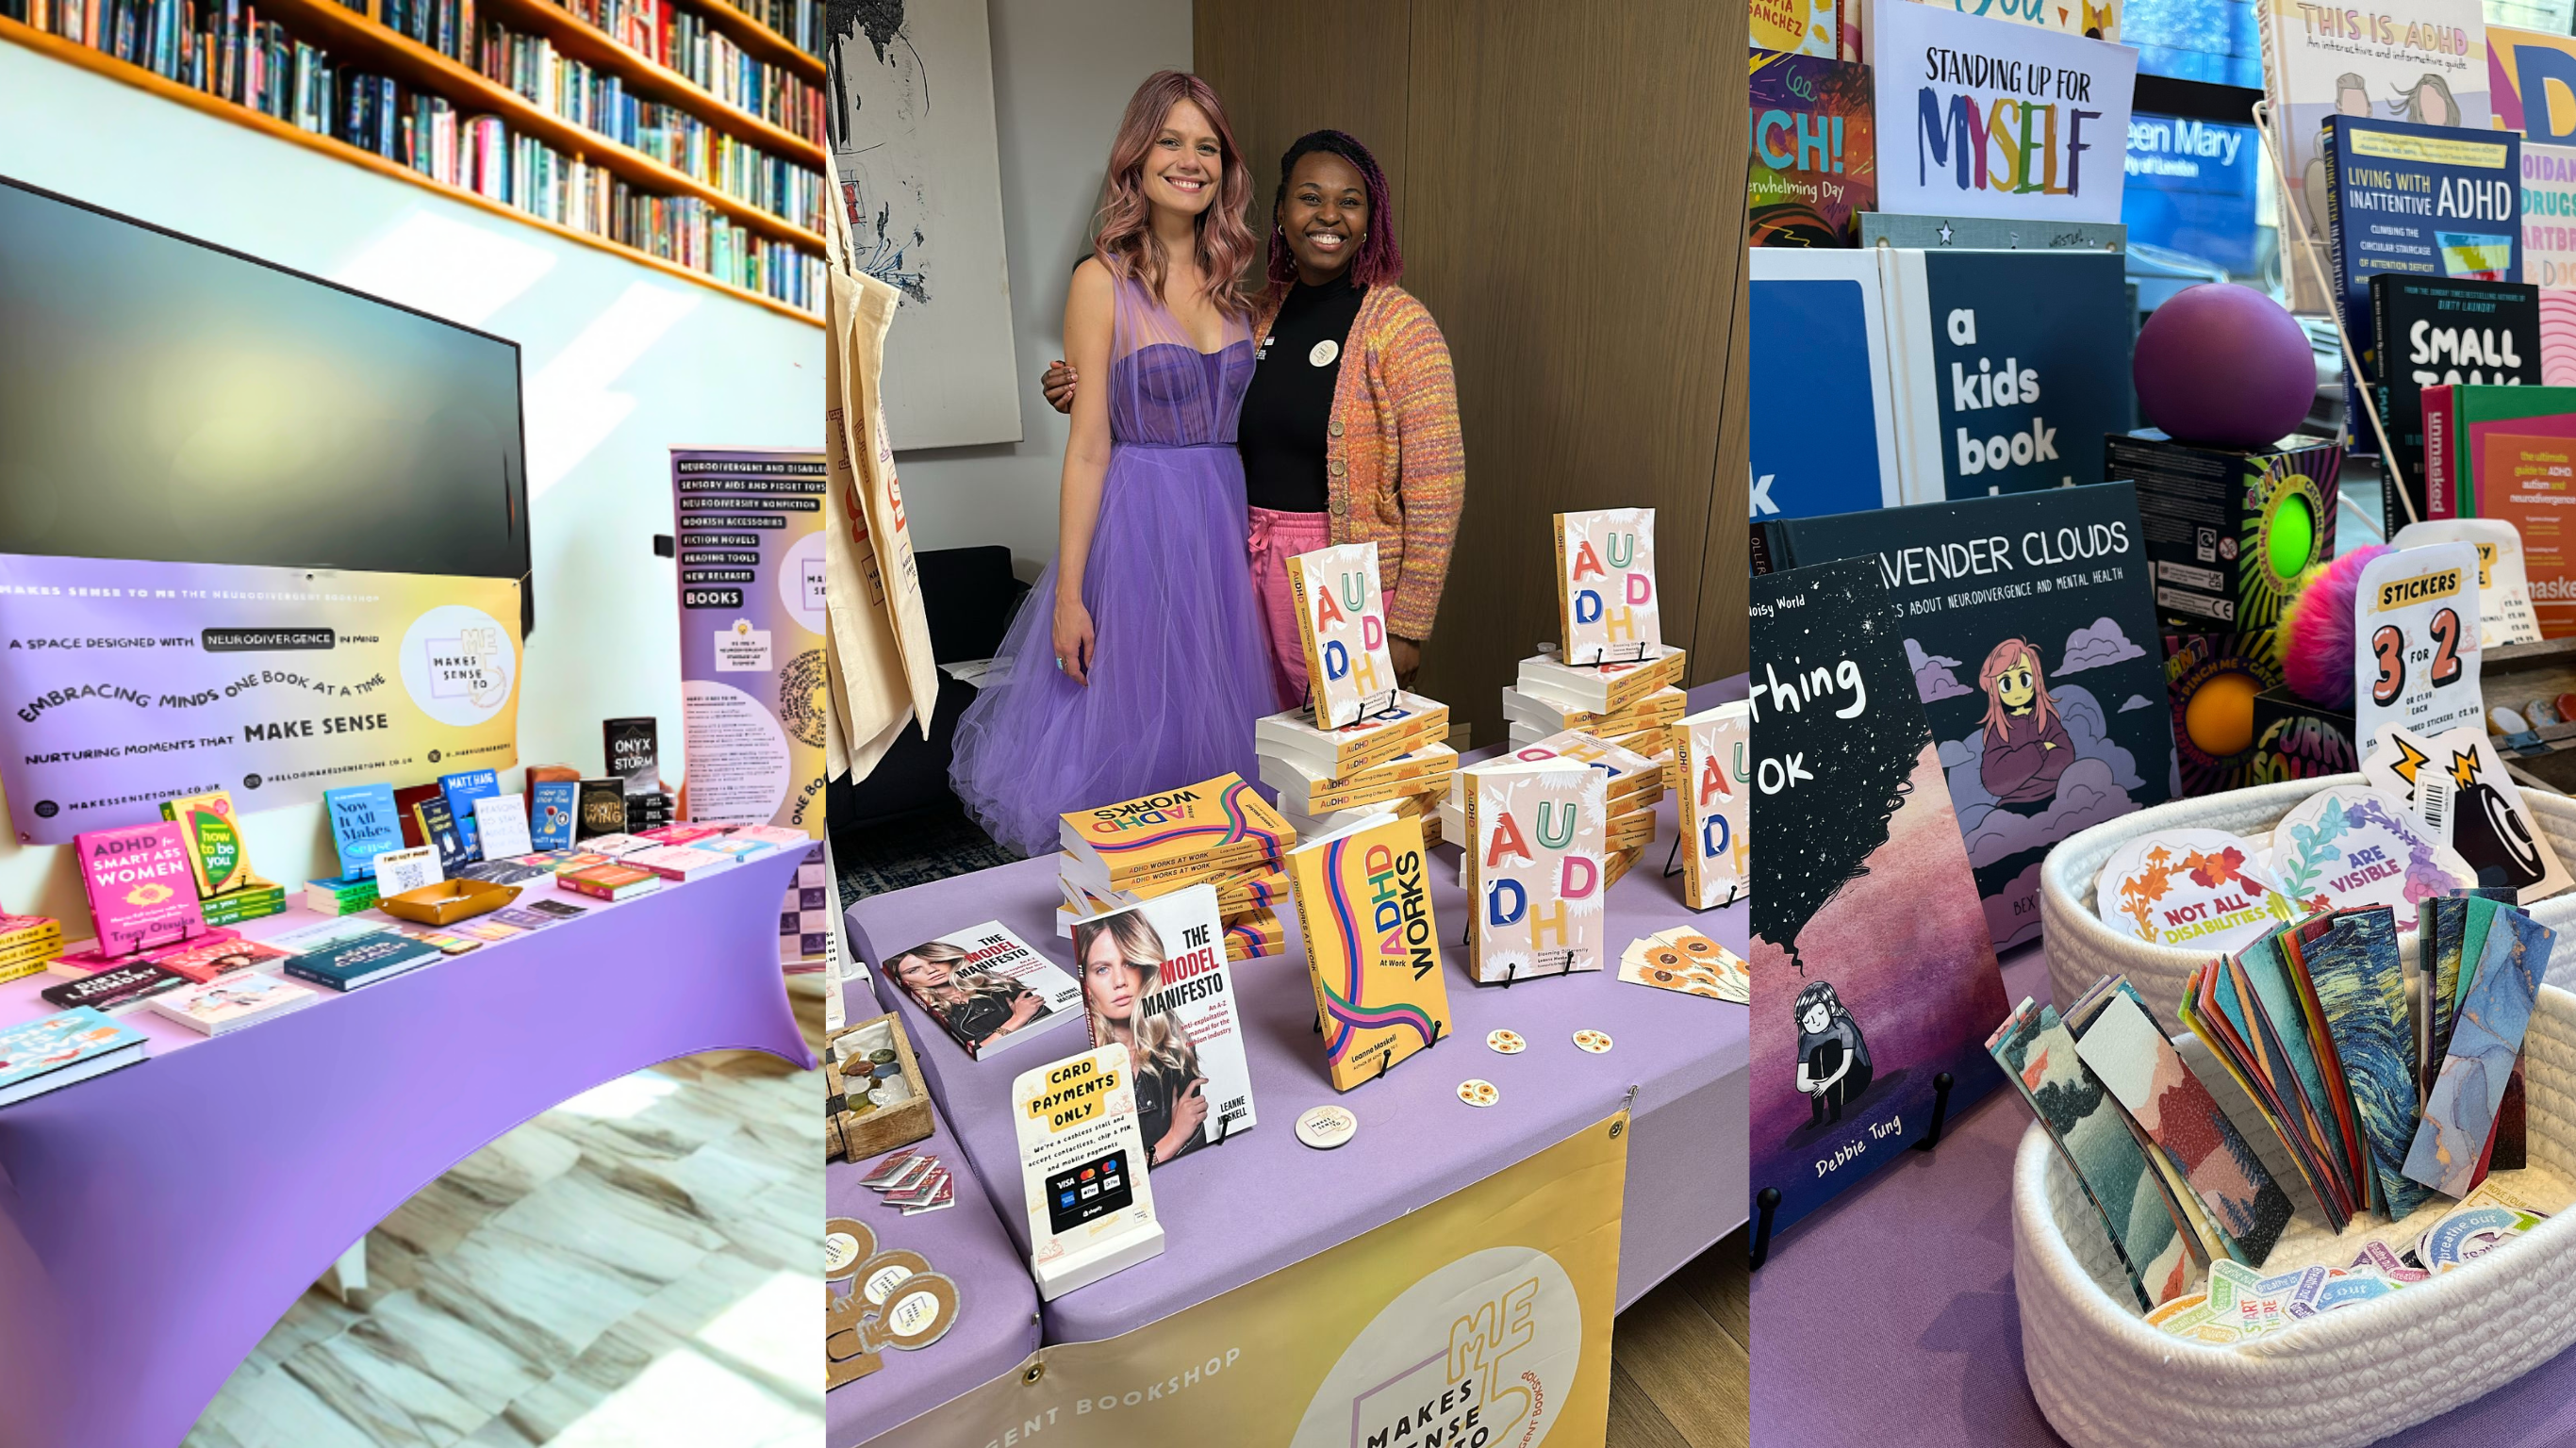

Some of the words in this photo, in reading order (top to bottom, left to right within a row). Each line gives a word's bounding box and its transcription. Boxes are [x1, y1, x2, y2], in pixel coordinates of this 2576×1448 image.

[2297, 2, 2359, 41] THIS
[2370, 13, 2392, 45] IS
[2404, 21, 2469, 57] ADHD
[2321, 39, 2373, 58] interactive
[2445, 58, 2469, 73] guide
[1925, 46, 2022, 94] STANDING
[2027, 62, 2052, 96] UP
[2056, 69, 2091, 104] FOR
[1918, 86, 2104, 199] MYSELF
[2173, 118, 2241, 167] Mary
[1823, 181, 1844, 204] Day
[2348, 167, 2391, 189] LIVING
[2395, 172, 2432, 194] WITH
[2349, 190, 2433, 216] INATTENTIVE
[2436, 176, 2512, 222] ADHD
[1947, 307, 1976, 346] a
[2409, 319, 2522, 370] SMALL
[1952, 357, 2040, 412] kids
[1956, 417, 2059, 476] book
[680, 462, 762, 472] NEURODIVERGENT
[766, 464, 784, 473] AND
[2428, 411, 2445, 514] unmasked
[681, 481, 722, 490] SENSORY
[725, 482, 746, 490] AIDS
[749, 482, 768, 490] AND
[770, 483, 801, 491] FIDGET
[684, 535, 718, 545] FICTION
[721, 536, 756, 545] NOVELS
[2023, 520, 2130, 567] CLOUDS
[685, 554, 725, 563] READING
[726, 554, 756, 563] TOOLS
[685, 572, 705, 582] NEW
[708, 572, 751, 581] RELEASES
[1292, 570, 1305, 603] AuDHD
[2383, 572, 2456, 605] STICKERS
[0, 584, 60, 596] MAKES
[68, 586, 121, 598] SENSE
[128, 588, 148, 599] TO
[156, 588, 176, 599] ME
[181, 589, 207, 600] THE
[212, 590, 321, 602] NEURODIVERGENT
[686, 592, 739, 604] BOOKS
[1776, 594, 1806, 610] World
[1909, 596, 1942, 617] ABOUT
[1948, 582, 2033, 611] NEURODIVERGENCE
[2037, 579, 2053, 594] AND
[2056, 571, 2090, 590] MENTAL
[2092, 567, 2124, 585] HEALTH
[8, 638, 23, 650] A
[26, 637, 82, 650] SPACE
[86, 637, 155, 650] DESIGNED
[159, 636, 195, 649] WITH
[207, 634, 331, 646] NEURODIVERGENCE
[339, 635, 351, 644] IN
[353, 635, 379, 644] MIND
[433, 656, 477, 667] MAKES
[2371, 624, 2405, 707] 3
[2410, 649, 2430, 664] FOR
[2429, 607, 2463, 689] 2
[443, 668, 483, 680] SENSE
[473, 680, 487, 689] TO
[17, 683, 151, 723] EMBRACING
[158, 688, 220, 708] MINDS
[224, 674, 259, 699] ONE
[261, 670, 310, 689] BOOK
[313, 683, 336, 697] AT
[339, 686, 352, 697] A
[355, 672, 386, 695] TIME
[2411, 704, 2428, 716] EACH
[2427, 713, 2454, 729] STICKERS
[25, 747, 121, 765] NURTURING
[124, 739, 195, 756] MOMENTS
[199, 736, 235, 749] THAT
[243, 719, 314, 744] MAKE
[323, 713, 388, 735] SENSE
[615, 738, 651, 753] ONYX
[1346, 739, 1369, 754] AuDHD
[615, 756, 652, 770] STORM
[1757, 751, 1814, 795] OK
[447, 776, 471, 789] MATT
[472, 772, 494, 785] HAIG
[1321, 778, 1350, 791] AuDHD
[337, 801, 368, 813] Now
[1093, 790, 1203, 821] WORKS
[1320, 796, 1349, 809] AuDHD
[1467, 789, 1476, 828] AuDHD
[355, 811, 375, 825] All
[585, 813, 623, 824] WING
[1092, 804, 1186, 834] ADHD
[202, 830, 230, 843] how
[341, 826, 392, 841] Makes
[93, 836, 157, 858] ADHD
[93, 852, 148, 871] SMART
[154, 847, 182, 861] ASS
[200, 844, 215, 854] to
[217, 842, 235, 854] be
[2347, 844, 2386, 870] ARE
[95, 860, 185, 887] WOMEN
[206, 854, 231, 869] you
[1129, 864, 1148, 874] ADHD
[1150, 859, 1177, 869] WORKS
[1178, 857, 1187, 865] AT
[1188, 852, 1209, 863] WORK
[1131, 875, 1150, 885] ADHD
[1152, 869, 1178, 880] WORKS
[1179, 867, 1189, 876] AT
[1190, 863, 1211, 873] WORK
[2329, 858, 2403, 895] VISIBLE
[1365, 844, 1407, 956] ADHD
[2013, 897, 2036, 916] BEX
[2163, 901, 2207, 928] NOT
[2215, 892, 2251, 916] ALL
[1395, 850, 1434, 981] WORKS
[2163, 906, 2267, 946] DISABILITIES
[110, 927, 147, 943] Tracy
[150, 916, 196, 933] Otsuka
[978, 933, 1006, 947] THE
[1182, 923, 1211, 949] THE
[1297, 899, 1309, 930] WORKS
[1307, 946, 1317, 973] WORK
[954, 947, 1030, 979] MANIFESTO
[963, 940, 1021, 964] MODEL
[1379, 959, 1387, 967] At
[1389, 959, 1407, 968] Work
[74, 968, 133, 991] DIRTY
[1159, 946, 1220, 987] MODEL
[65, 967, 157, 1000] LAUNDRY
[1141, 972, 1224, 1019] MANIFESTO
[1209, 1004, 1216, 1012] An
[1217, 1001, 1228, 1010] A-Z
[1181, 1010, 1229, 1032] anti-exploitation
[1188, 1025, 1209, 1038] manual
[1220, 1018, 1230, 1028] the
[1185, 1036, 1208, 1048] fashion
[1207, 1027, 1231, 1043] industry
[1350, 1045, 1374, 1063] Leanne
[1374, 1032, 1397, 1052] Maskell
[1051, 1061, 1092, 1084] CARD
[1032, 1074, 1115, 1113] PAYMENTS
[1220, 1095, 1246, 1113] LEANNE
[1054, 1103, 1093, 1127] ONLY
[1311, 1115, 1331, 1128] MAKES
[1033, 1141, 1055, 1154] We're
[1064, 1127, 1093, 1143] cashless
[1095, 1120, 1112, 1133] stall
[1113, 1114, 1125, 1124] and
[1815, 1139, 1867, 1178] Debbie
[1868, 1114, 1903, 1140] Tung
[1028, 1155, 1052, 1169] accept
[1053, 1140, 1096, 1160] contactless,
[1098, 1132, 1112, 1144] chip
[1047, 1163, 1060, 1173] and
[1062, 1155, 1085, 1168] mobile
[1087, 1142, 1118, 1159] payments
[1056, 1176, 1076, 1190] VISA
[2485, 1183, 2504, 1198] MOVE
[2437, 1219, 2467, 1261] breathe
[2469, 1213, 2497, 1225] out
[2240, 1299, 2262, 1333] START
[2262, 1299, 2281, 1328] HERE
[1446, 1276, 1539, 1385] ME
[1076, 1347, 1241, 1415] BOOKSHOP
[1521, 1370, 1544, 1418] BOOKSHOP
[1367, 1379, 1472, 1448] MAKES
